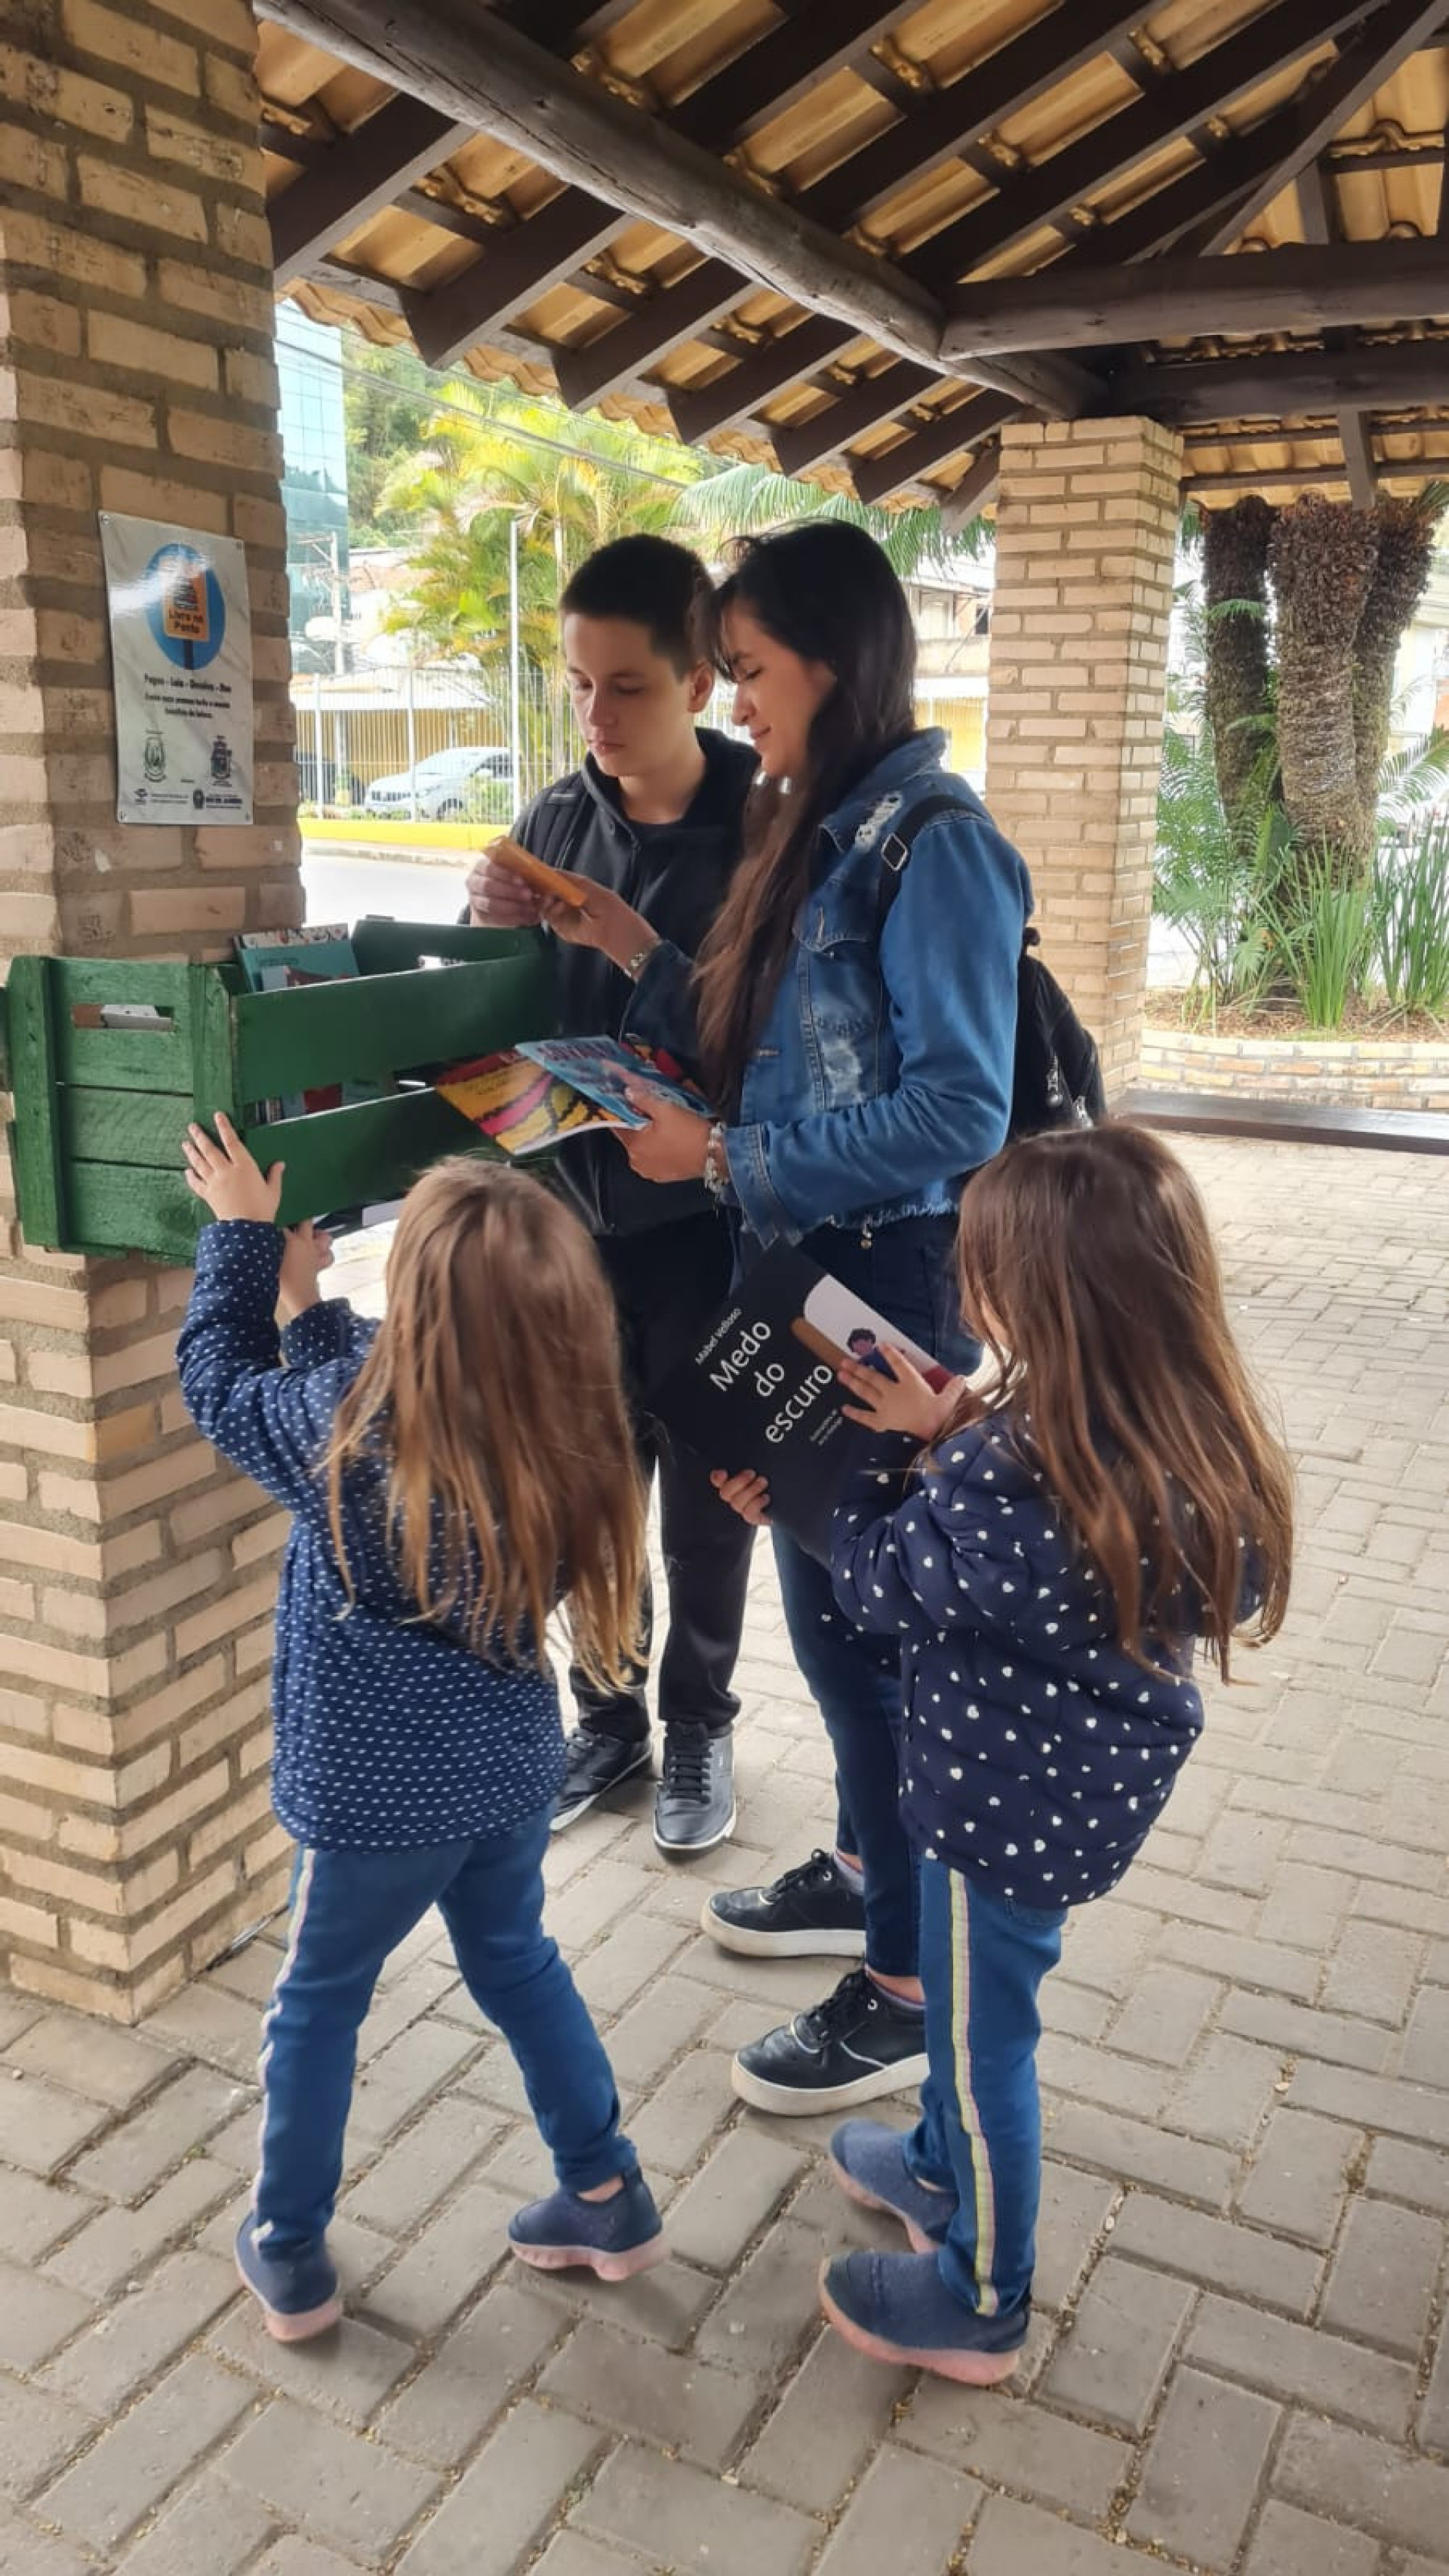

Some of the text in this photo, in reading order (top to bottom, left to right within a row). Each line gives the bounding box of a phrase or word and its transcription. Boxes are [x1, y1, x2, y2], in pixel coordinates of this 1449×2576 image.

[710, 1322, 771, 1391] Medo
[754, 1363, 785, 1397] do
[765, 1365, 833, 1443] escuro
